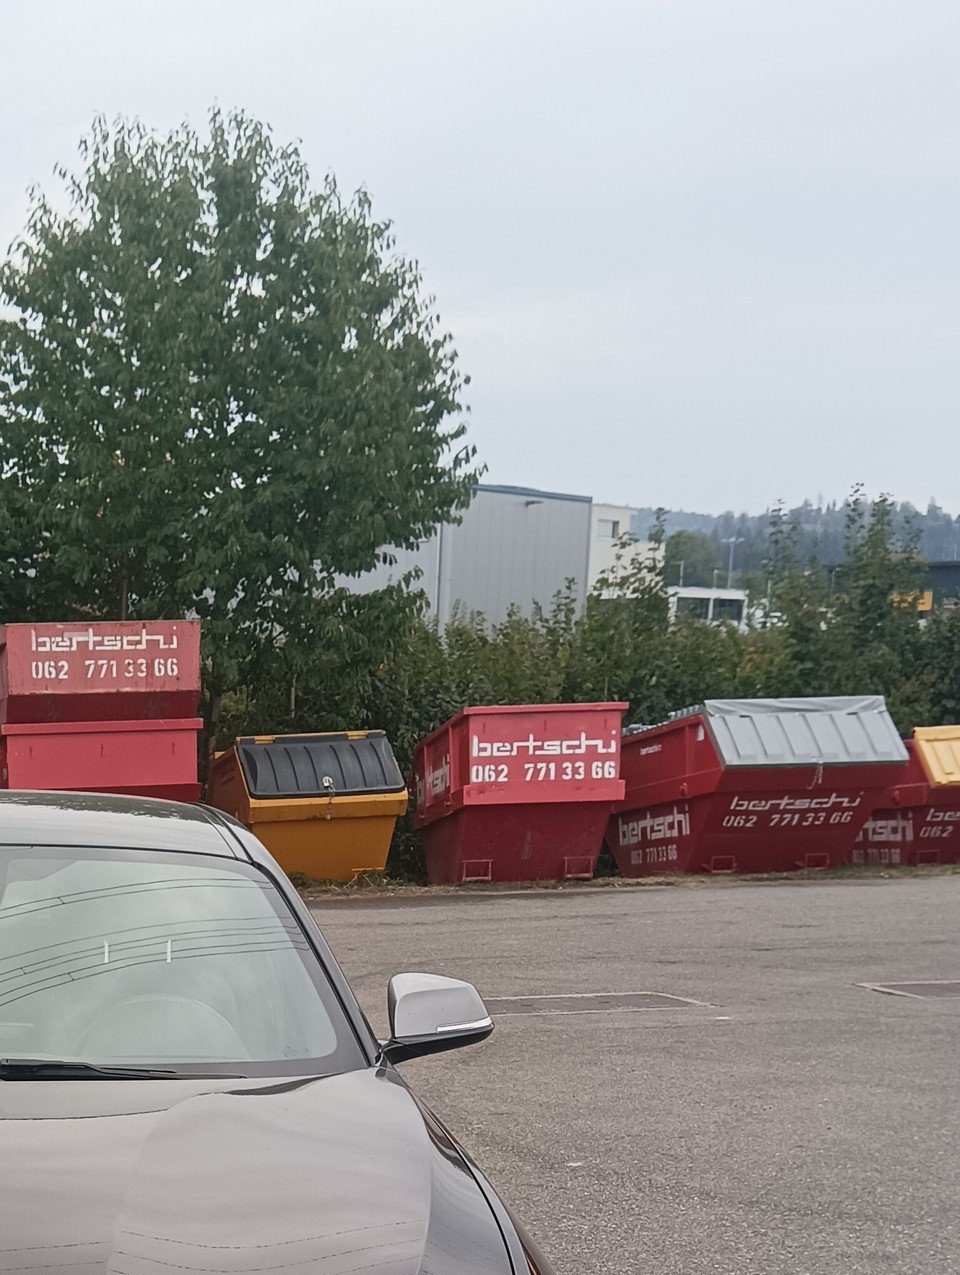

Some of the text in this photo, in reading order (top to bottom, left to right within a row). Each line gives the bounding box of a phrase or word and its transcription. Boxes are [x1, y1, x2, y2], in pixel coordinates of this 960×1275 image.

[31, 626, 177, 651] bertschi
[31, 657, 178, 679] 062 771 33 66
[472, 729, 617, 757] bertschi
[471, 760, 616, 783] 062 771 33 66
[730, 791, 864, 810] bertschi
[619, 803, 690, 846] bertschi
[722, 811, 853, 827] 062 771 33 66
[920, 826, 954, 838] 062
